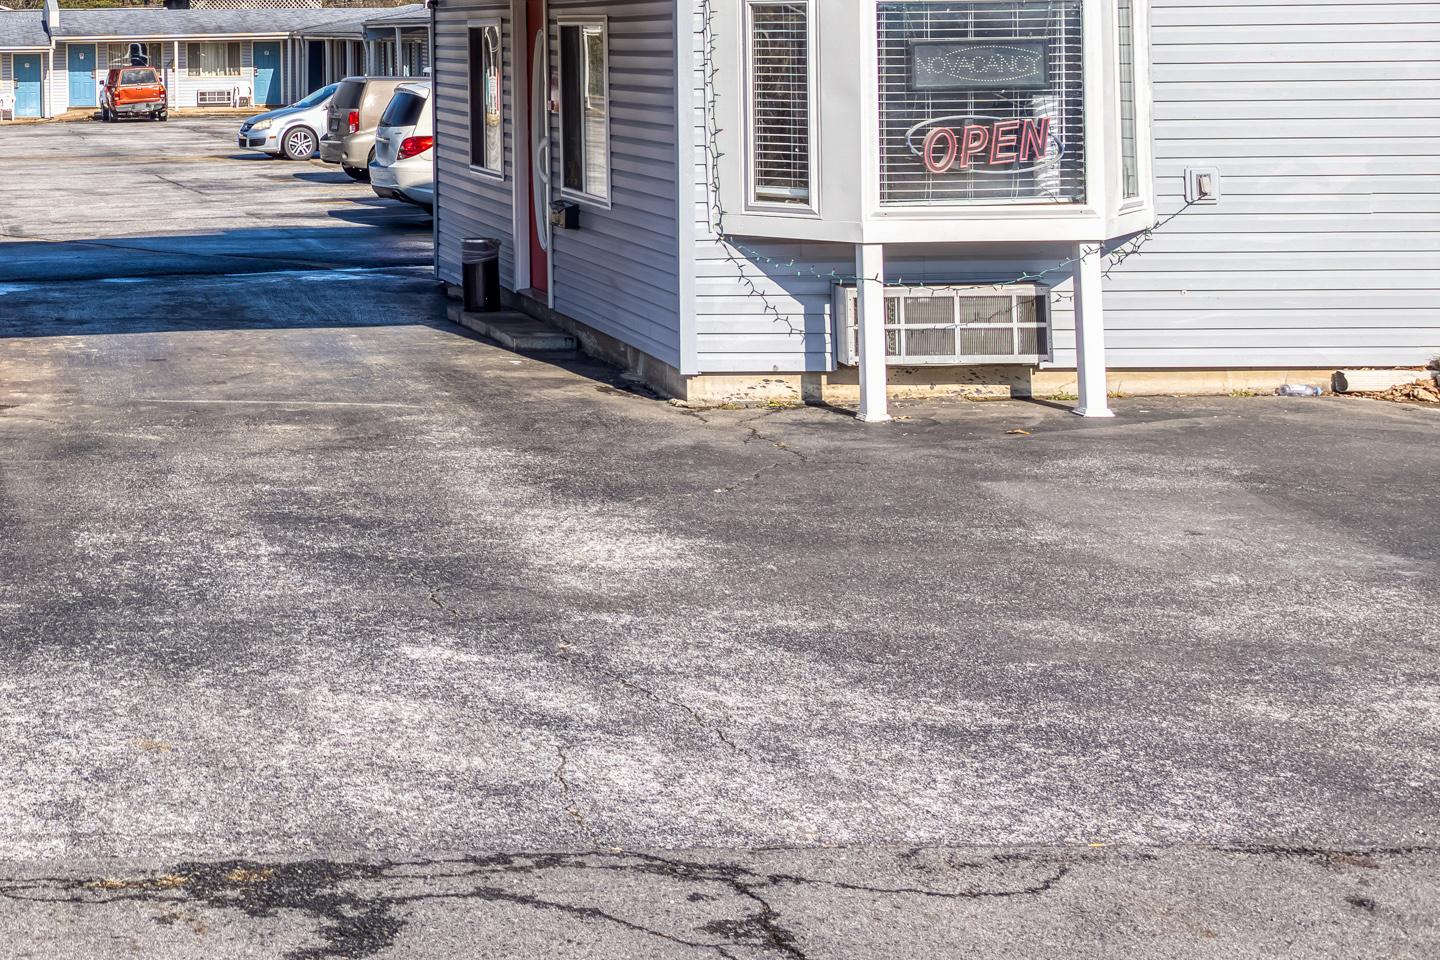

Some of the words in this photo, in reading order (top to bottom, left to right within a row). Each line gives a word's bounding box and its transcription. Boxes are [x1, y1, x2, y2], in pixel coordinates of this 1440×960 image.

[917, 56, 946, 74] NO
[945, 54, 1039, 74] VACANCY
[923, 117, 1050, 174] OPEN
